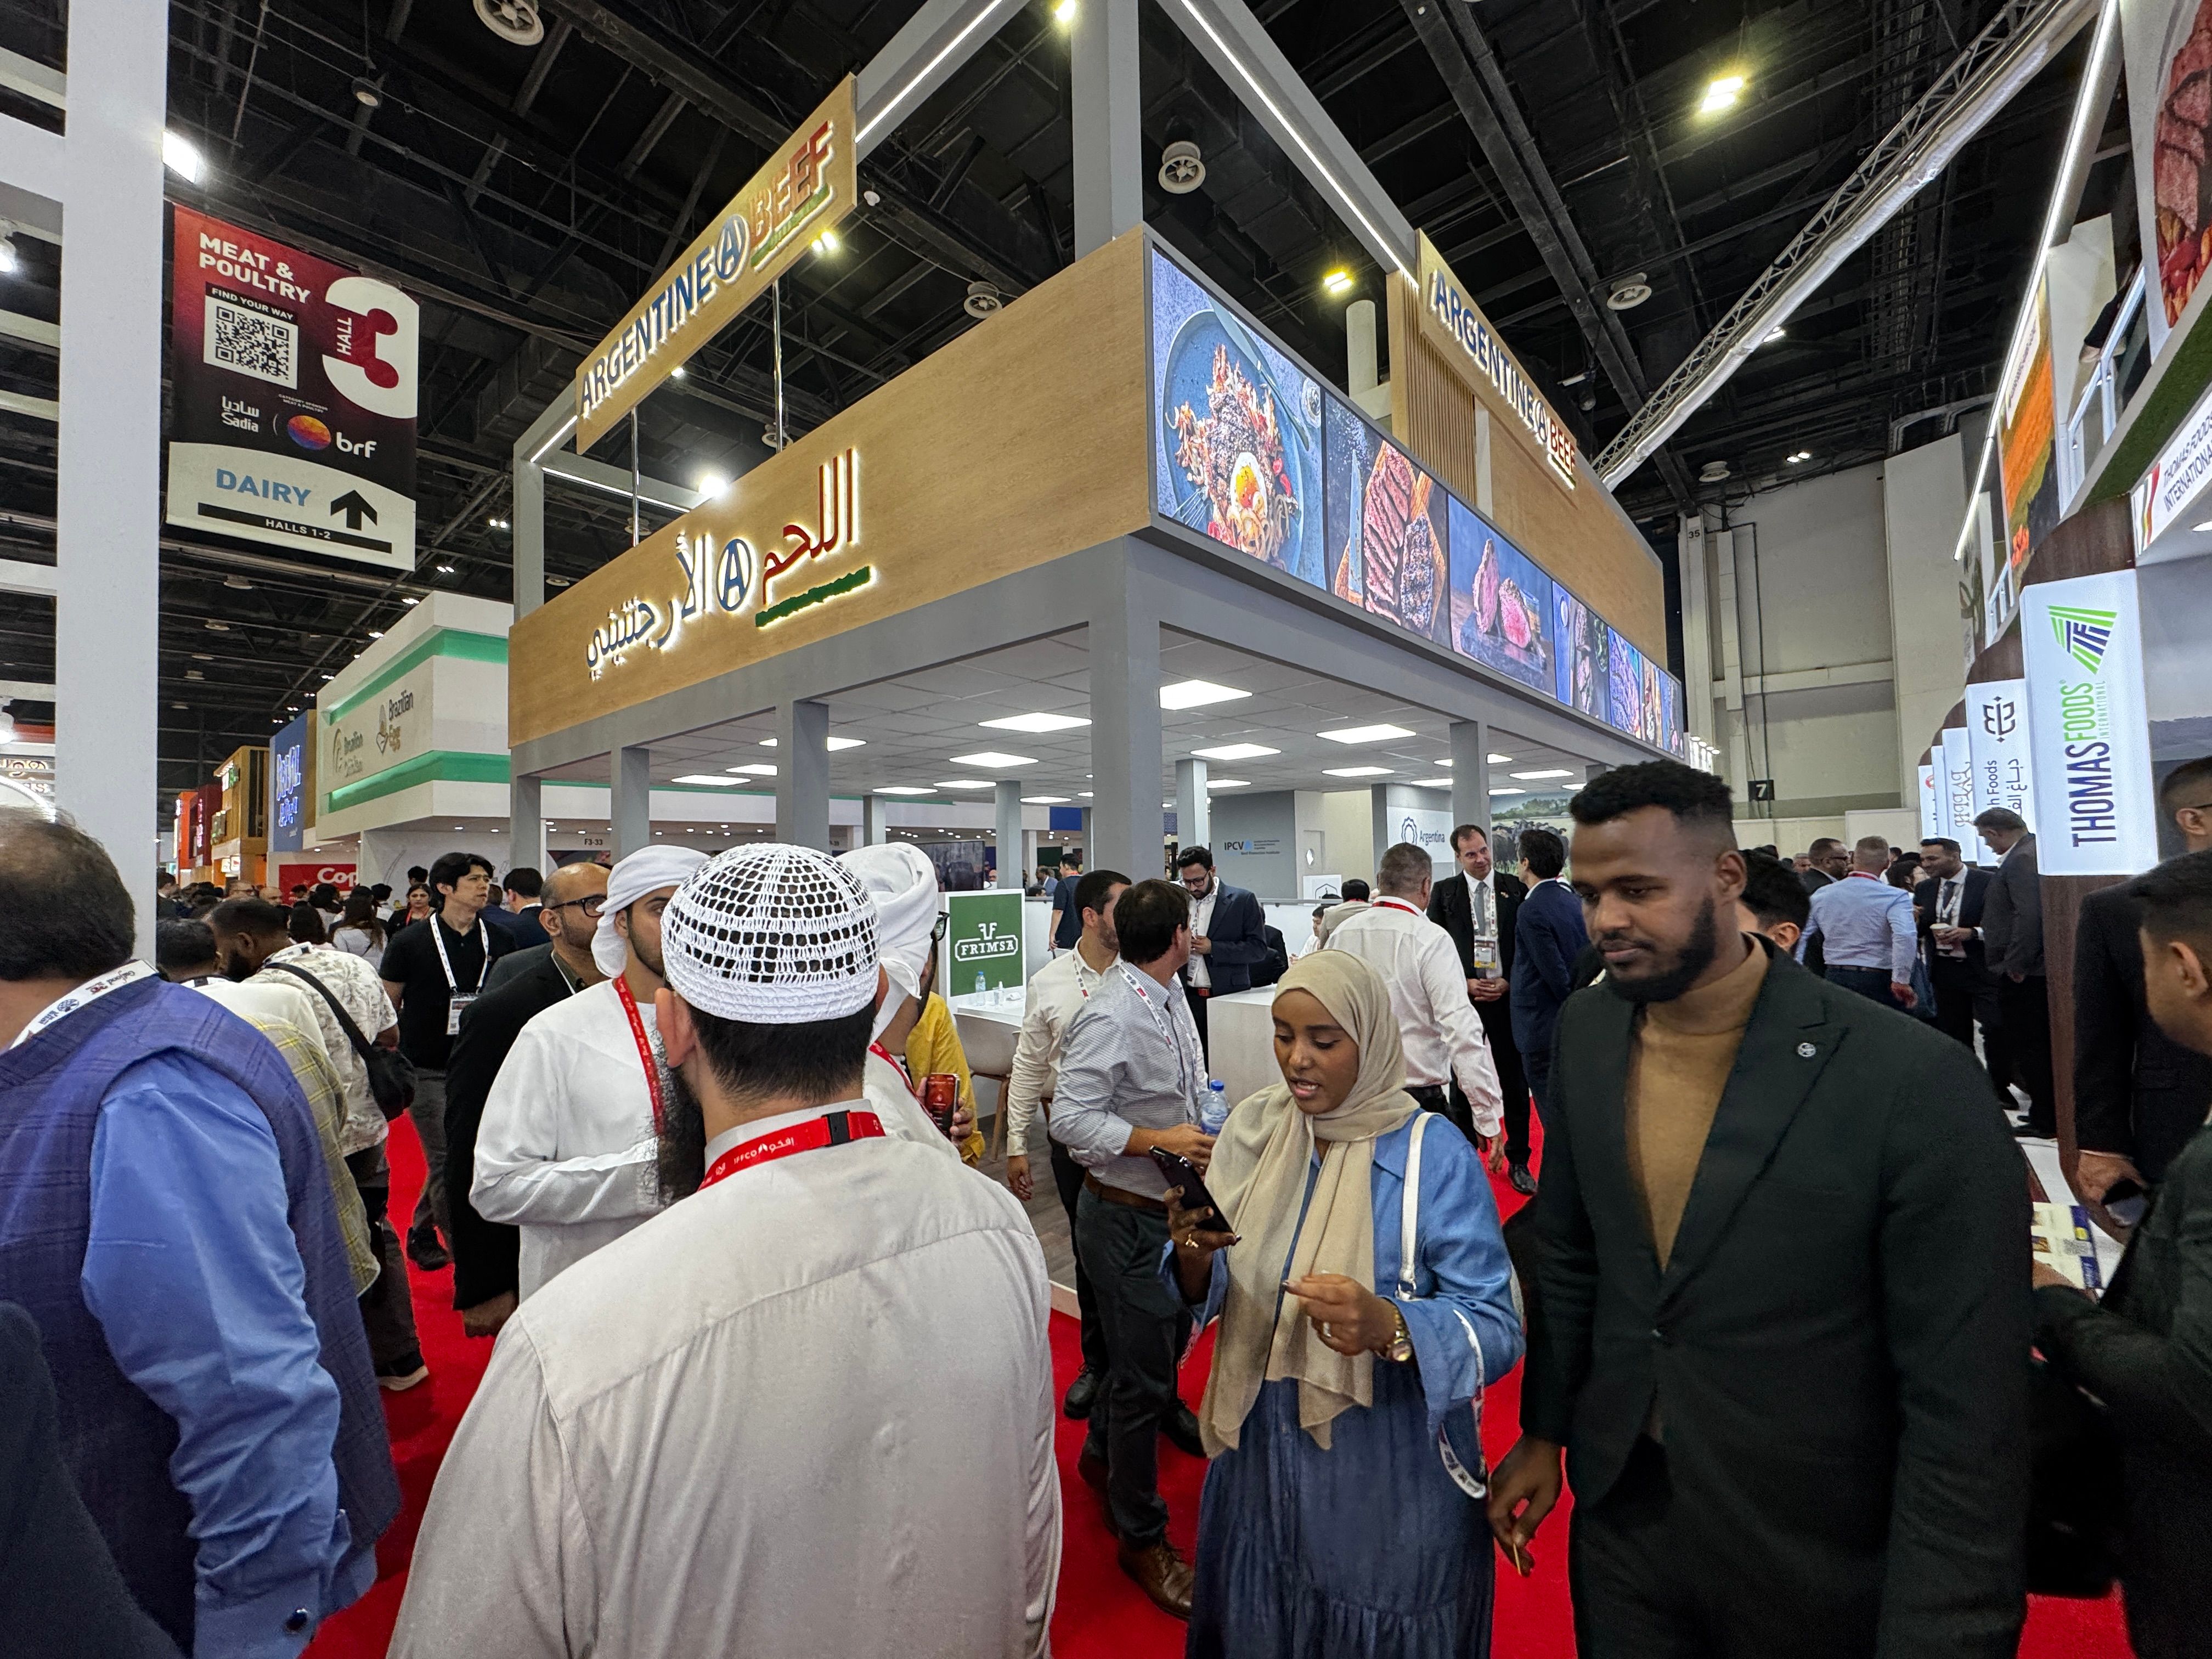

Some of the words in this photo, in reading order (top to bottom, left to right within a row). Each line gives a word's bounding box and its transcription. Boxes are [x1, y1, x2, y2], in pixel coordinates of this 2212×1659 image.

[200, 232, 270, 270] MEAT
[276, 262, 294, 282] &
[581, 246, 715, 416] ARGENTINE
[749, 120, 833, 248] BEEF
[200, 252, 311, 303] POULTRY
[212, 287, 238, 301] FIND
[240, 297, 269, 313] YOUR
[271, 307, 294, 320] WAY
[323, 276, 419, 419] 3
[336, 318, 352, 356] HALL
[1432, 269, 1535, 429] ARGENTINE
[1548, 417, 1576, 475] BEEF
[221, 396, 259, 417] ساديا
[278, 394, 304, 404] CATEGORY
[221, 412, 258, 432] Sadia
[2189, 410, 2212, 455] FOOD
[336, 432, 377, 458] brf
[216, 469, 311, 506] DAIRY
[2164, 439, 2212, 512] INTERNATIONA
[266, 519, 307, 534] HALLS
[312, 529, 331, 539] 1-2
[763, 448, 857, 605] اللحم
[1688, 529, 1700, 539] 35
[587, 532, 712, 681] الأرجنتيني
[389, 690, 414, 721] Brazilian
[2096, 680, 2110, 739] INTERNATIONAL
[1756, 783, 1767, 798] 7
[1984, 760, 2000, 794] Foods
[1224, 841, 1244, 850] IPCV
[1419, 830, 1445, 846] Argentina
[961, 940, 1014, 956] FRIMSA
